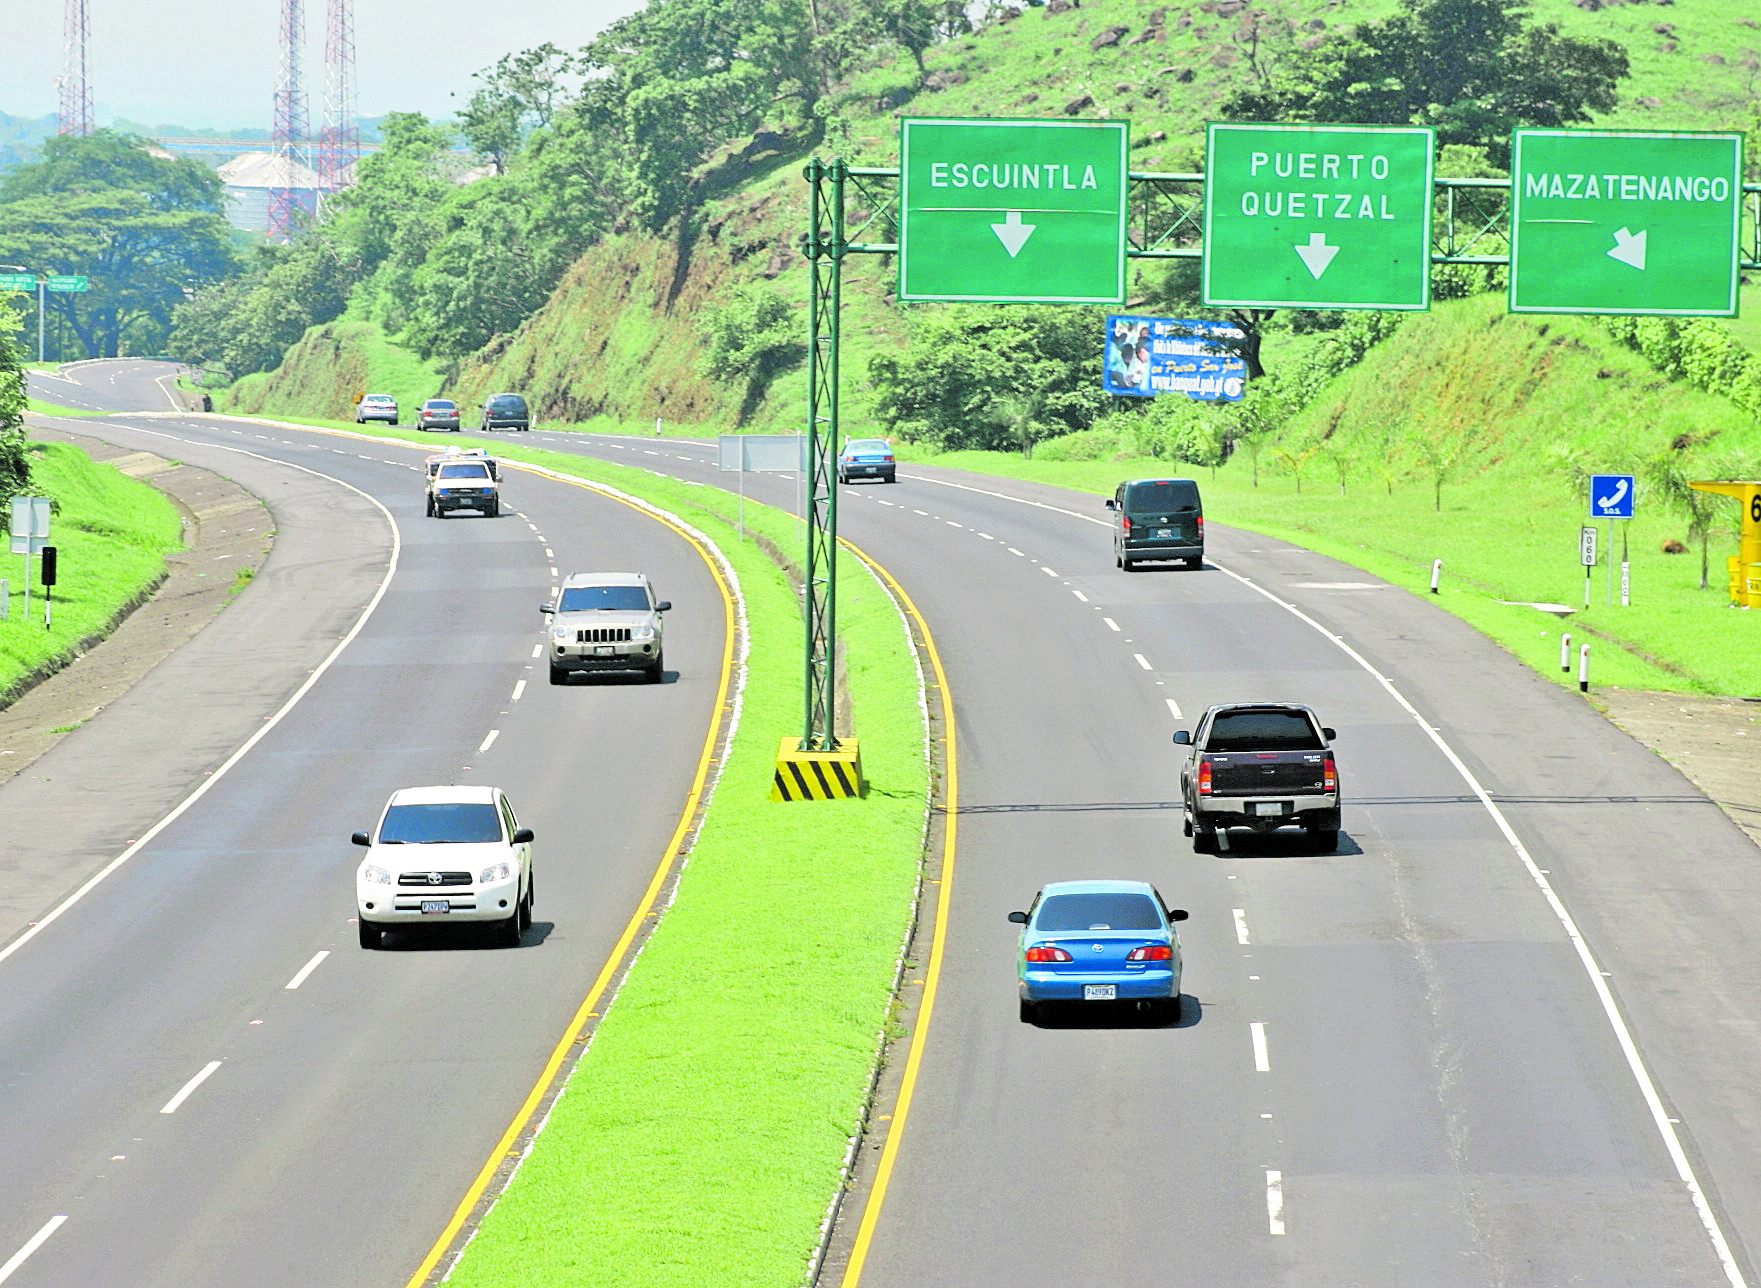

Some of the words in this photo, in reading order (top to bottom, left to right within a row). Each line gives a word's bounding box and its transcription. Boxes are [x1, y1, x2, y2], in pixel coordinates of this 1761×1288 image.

[931, 162, 1097, 190] ESCUINTLA
[1251, 152, 1389, 180] PUERTO
[1525, 173, 1729, 203] MAZATENANGO
[1242, 191, 1395, 219] QUETZAL
